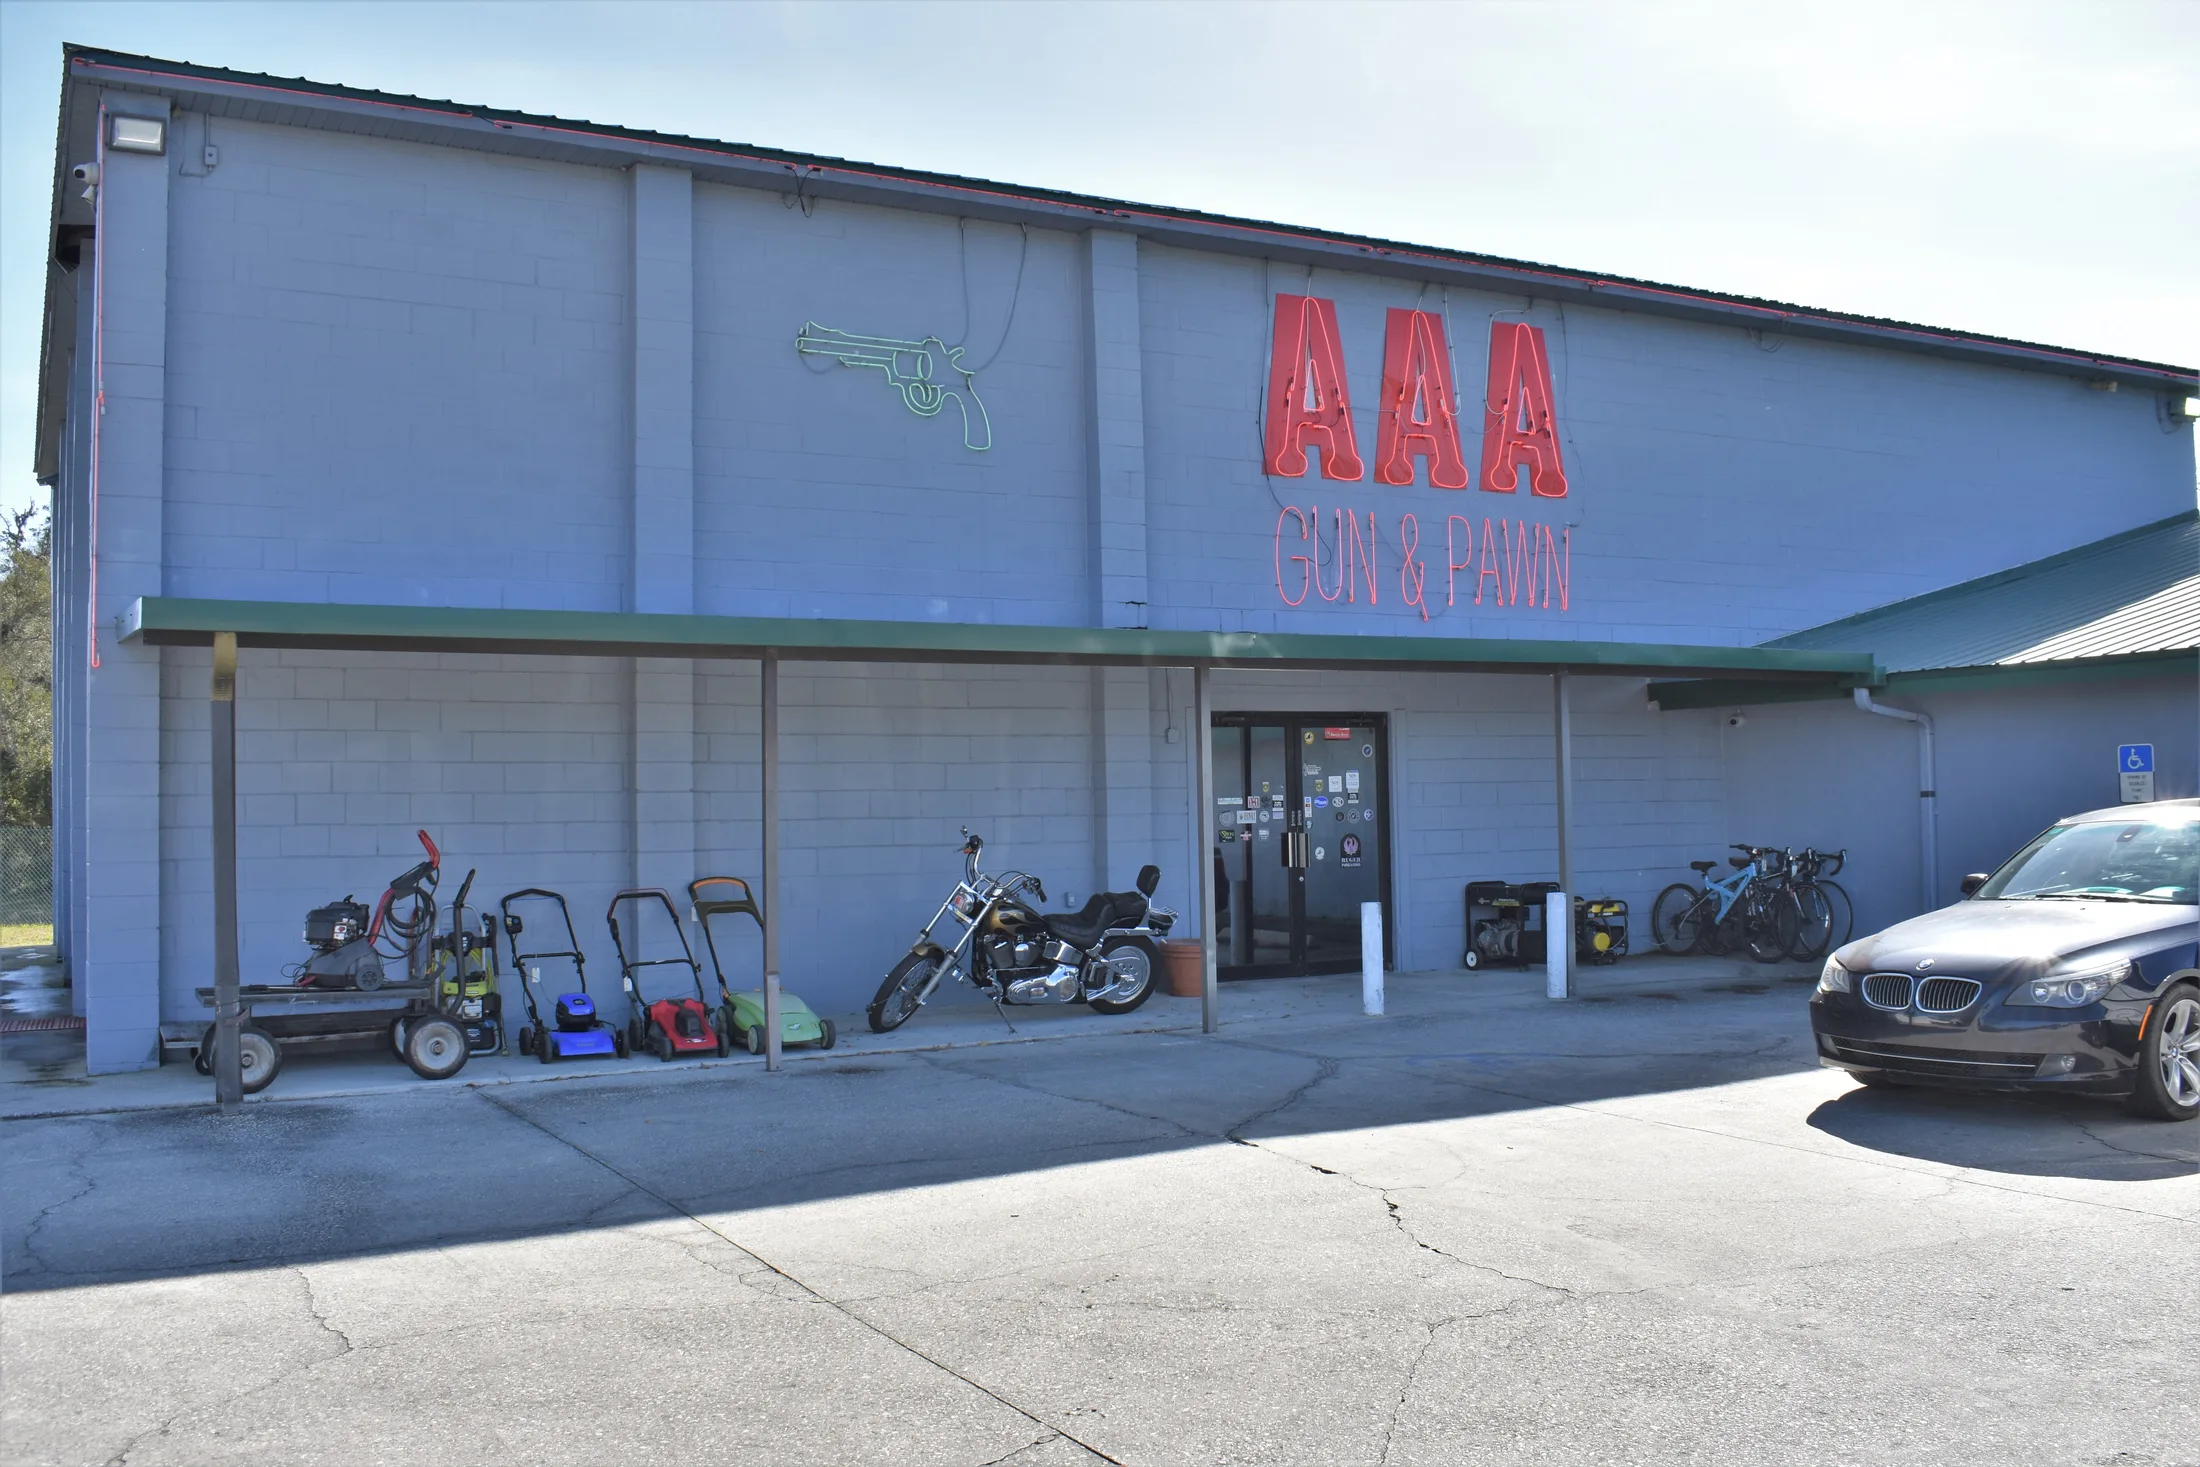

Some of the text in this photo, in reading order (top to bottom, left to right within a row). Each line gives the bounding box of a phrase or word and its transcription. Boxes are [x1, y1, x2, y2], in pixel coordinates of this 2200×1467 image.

[1262, 293, 1568, 499] AAA
[1276, 506, 1569, 622] GUN & PAWN
